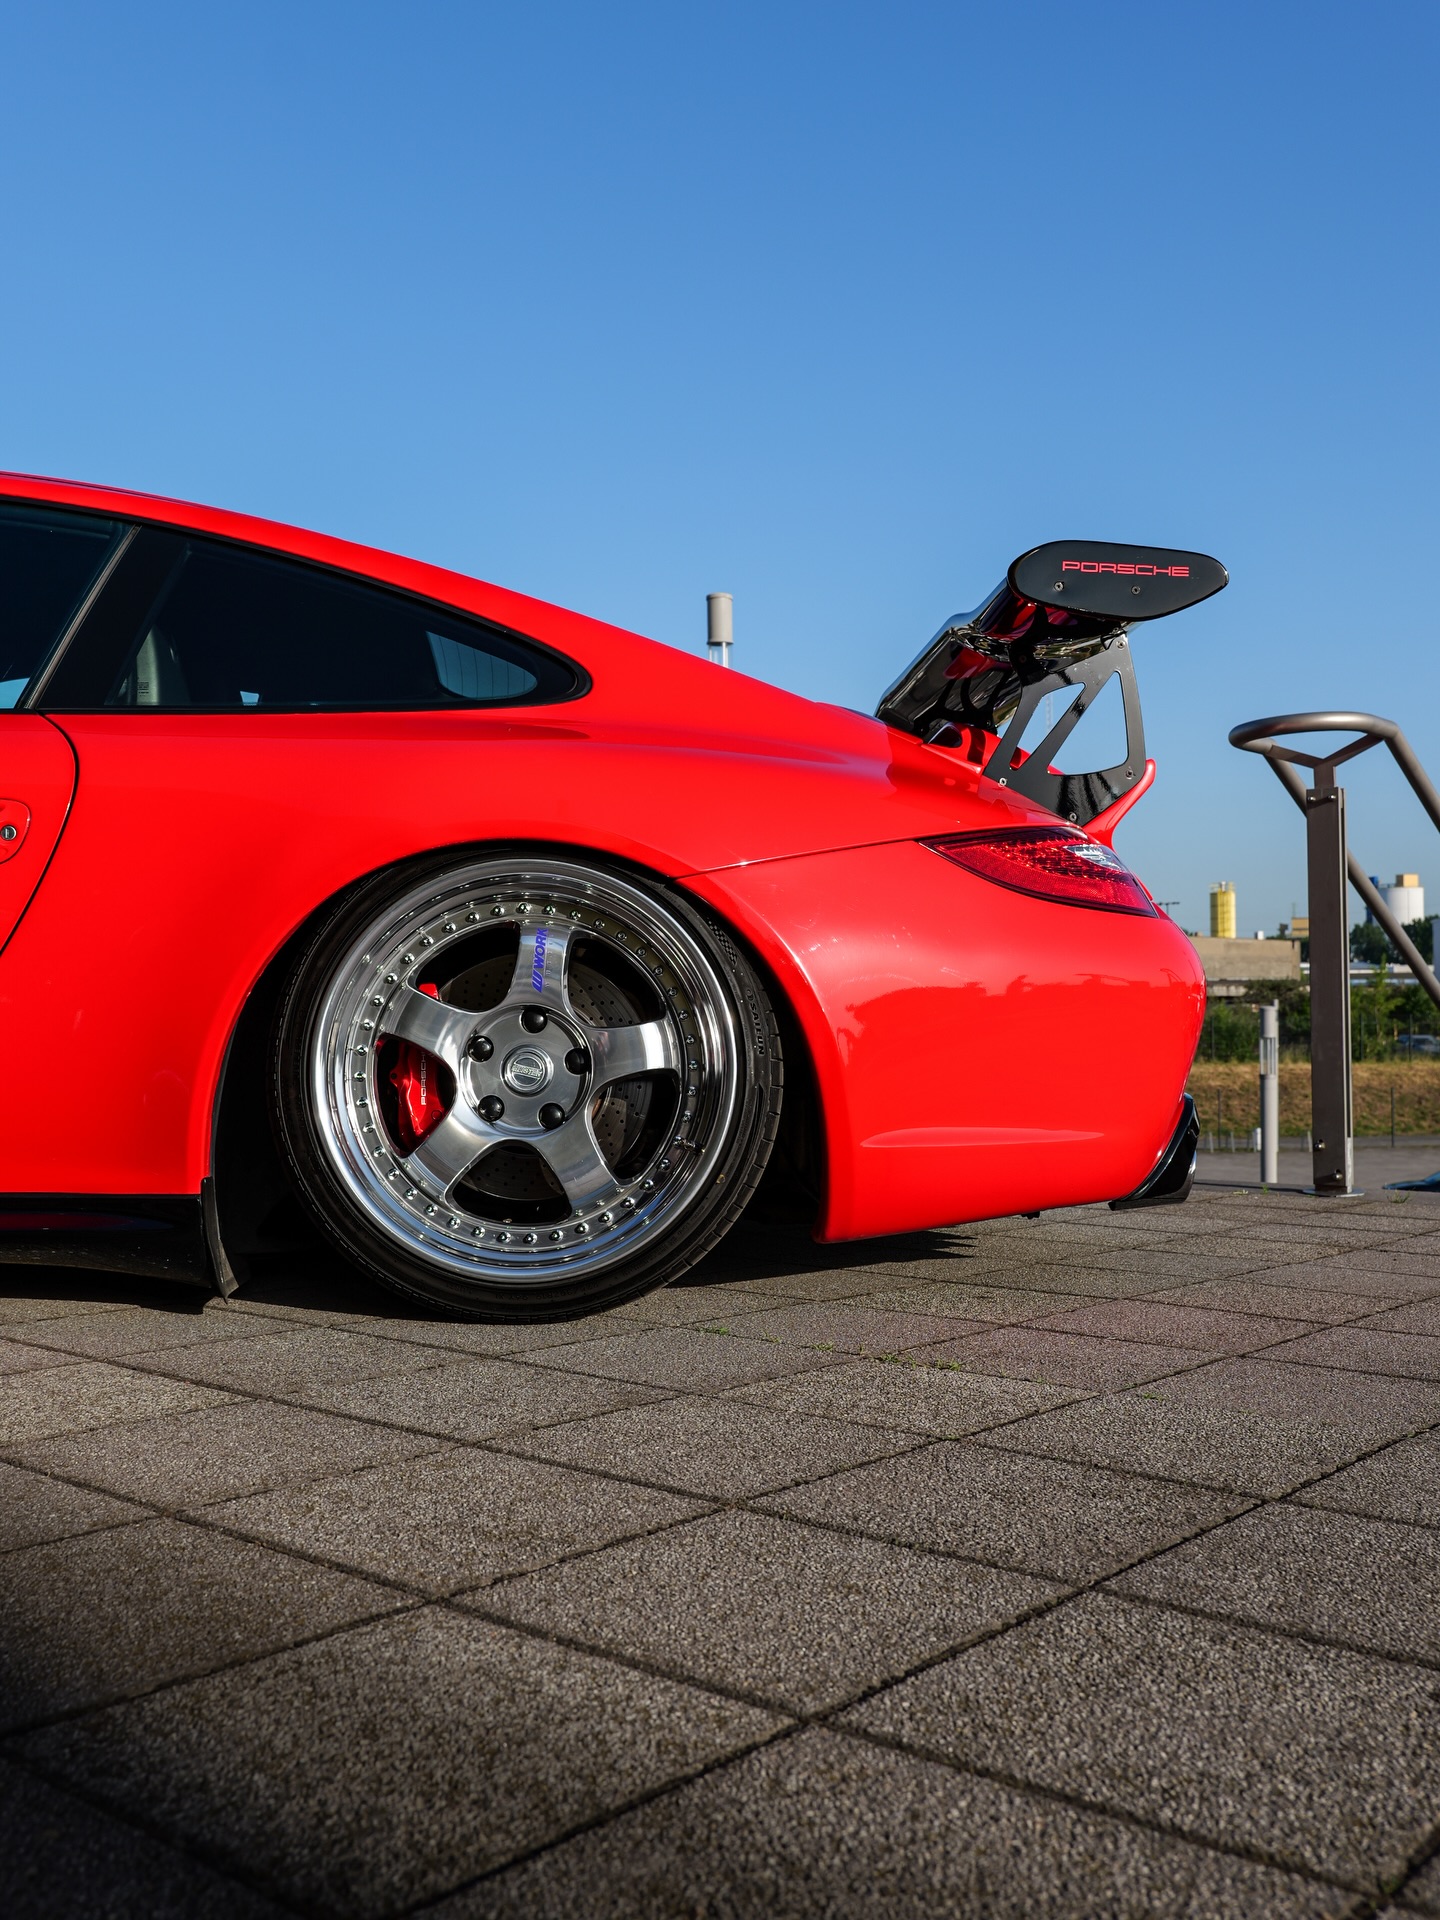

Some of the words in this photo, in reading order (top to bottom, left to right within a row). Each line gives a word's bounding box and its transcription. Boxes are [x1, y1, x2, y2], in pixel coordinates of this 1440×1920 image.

[1062, 560, 1190, 577] PORSCHE
[533, 927, 549, 969] WORK
[750, 1002, 765, 1055] SAILUN
